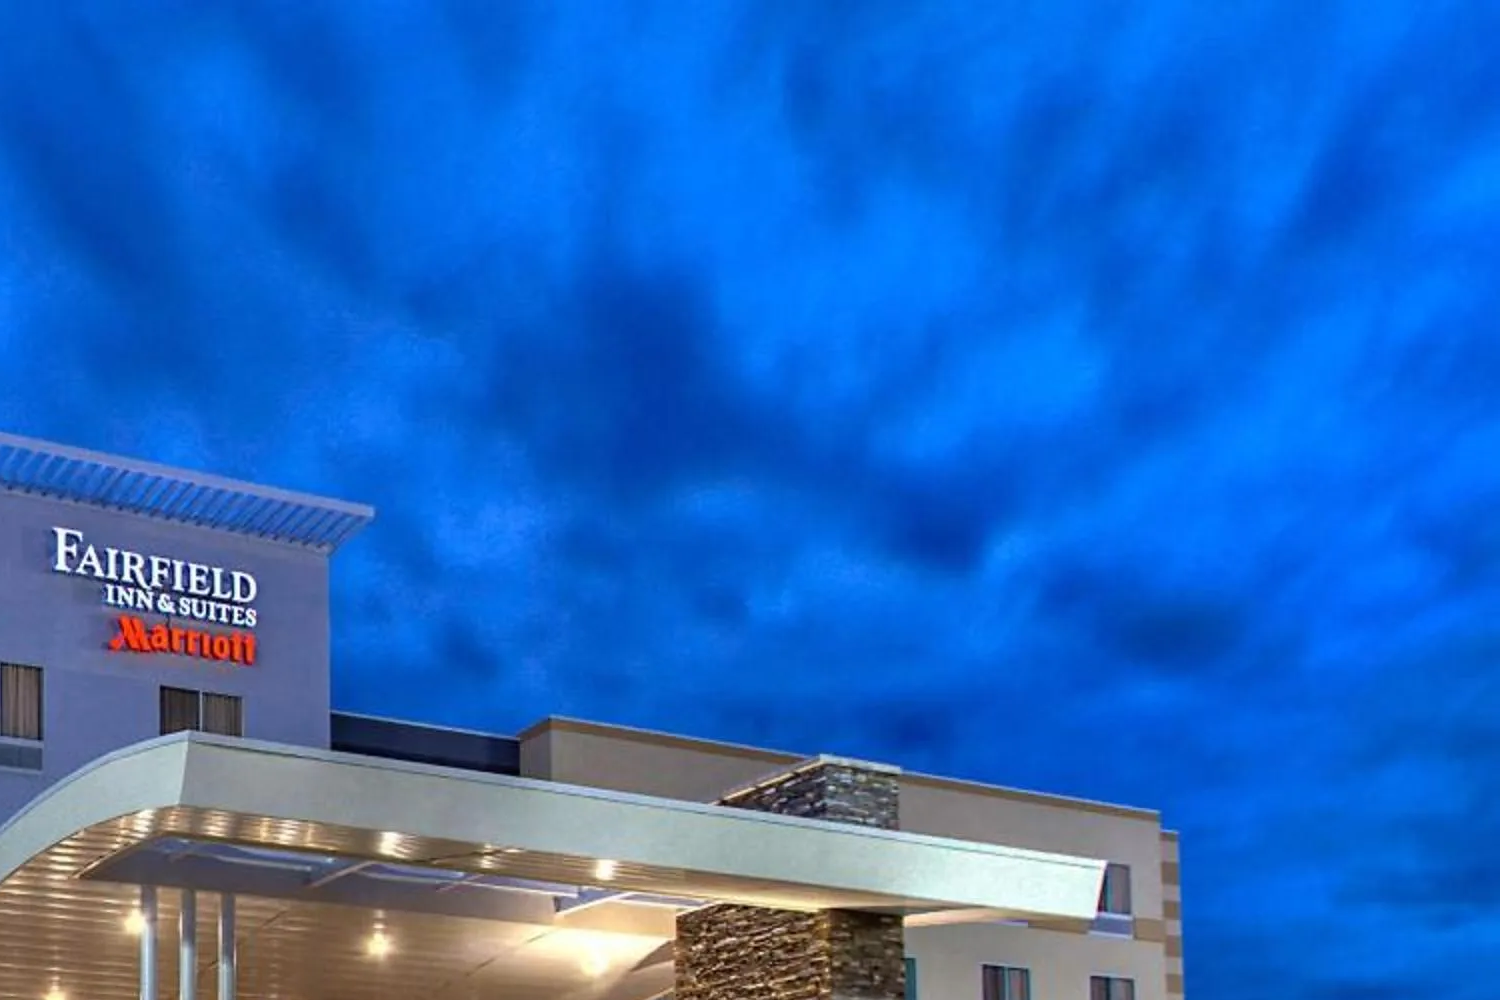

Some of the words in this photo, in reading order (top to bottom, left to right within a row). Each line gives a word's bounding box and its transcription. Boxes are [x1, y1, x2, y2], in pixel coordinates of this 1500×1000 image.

[52, 526, 257, 602] FAIRFIELD
[105, 584, 154, 612] INN
[159, 593, 176, 613] &
[179, 597, 257, 627] SUITES
[109, 614, 257, 665] Marriott
